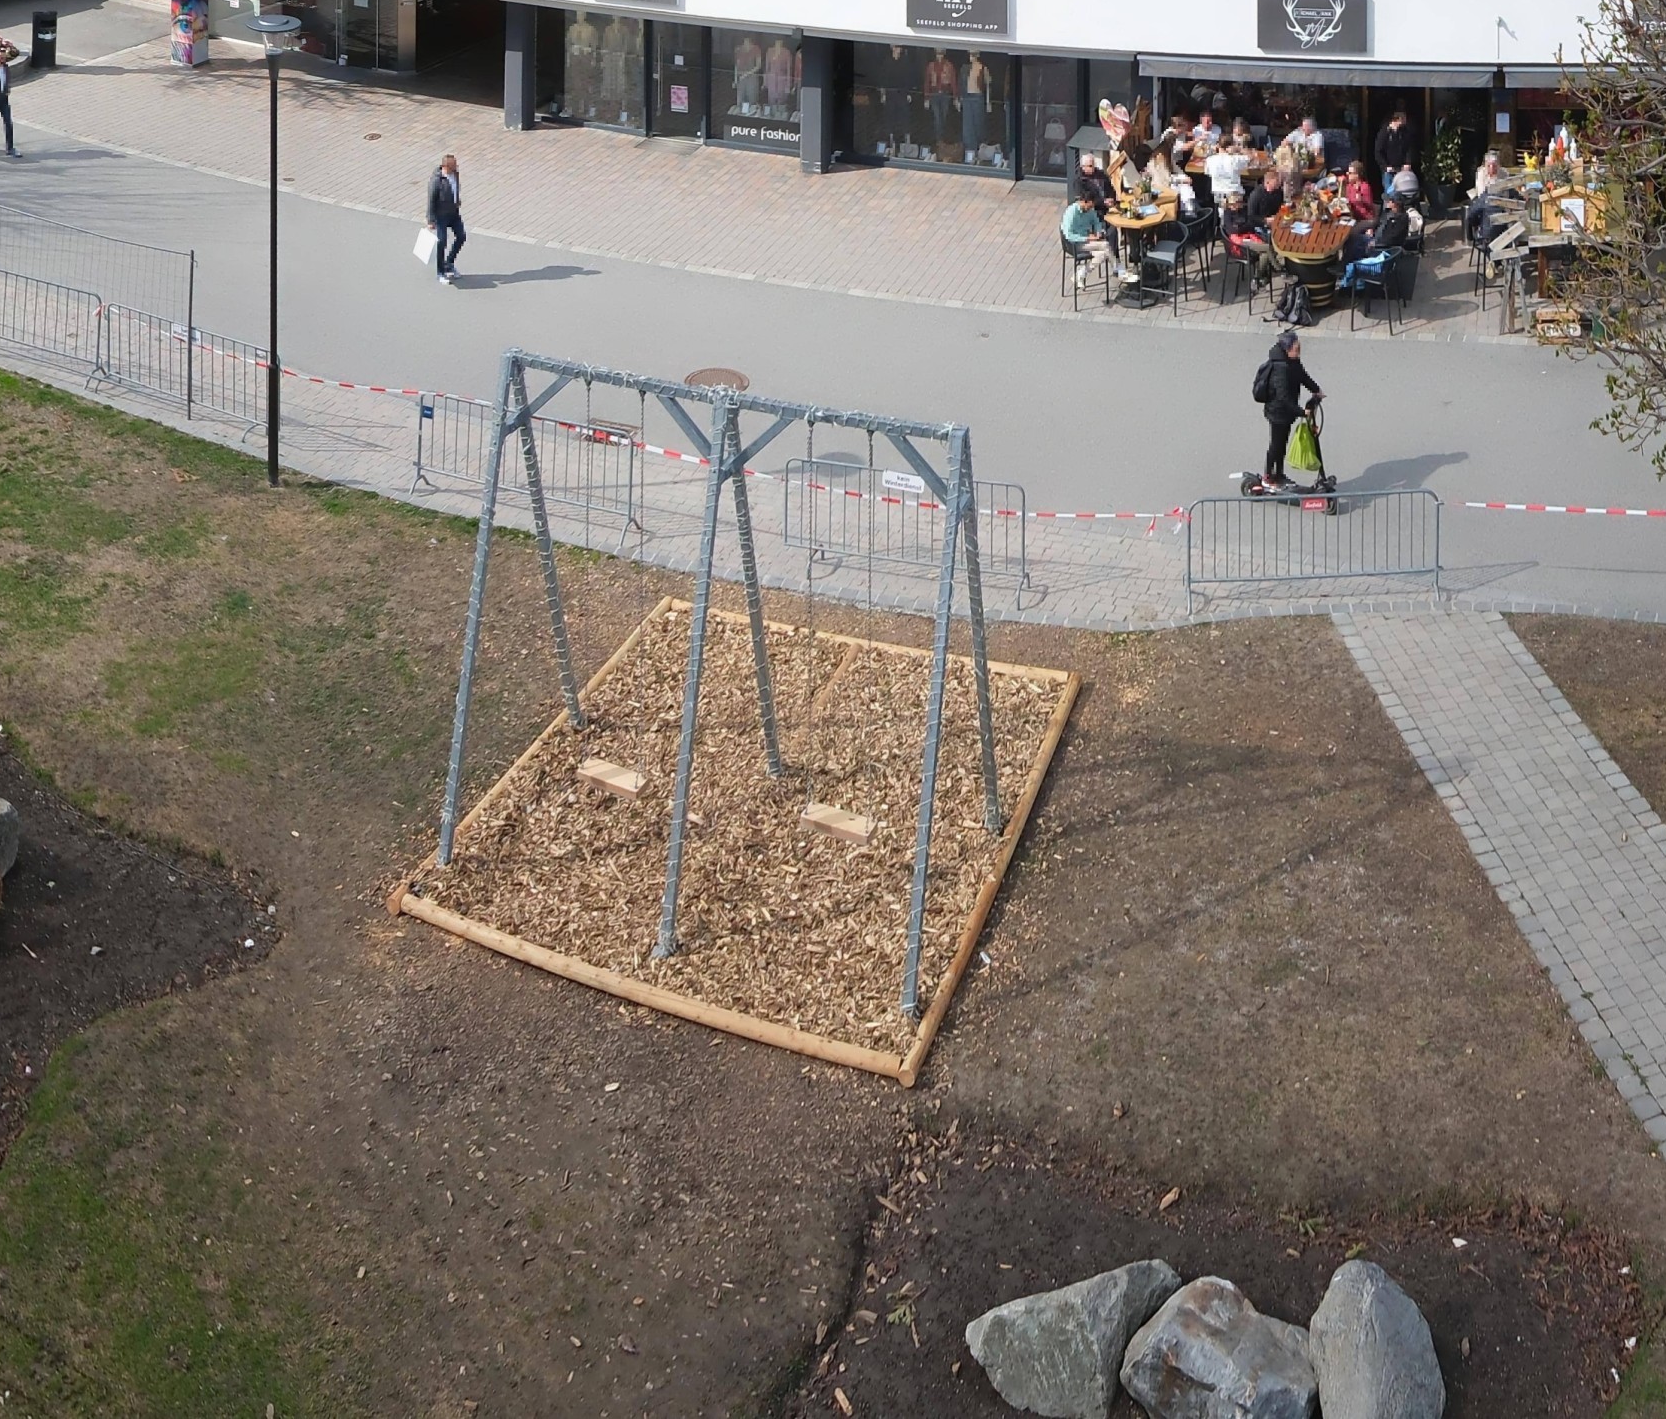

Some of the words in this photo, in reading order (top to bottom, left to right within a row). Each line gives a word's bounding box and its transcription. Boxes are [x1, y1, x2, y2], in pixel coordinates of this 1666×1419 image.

[916, 19, 945, 27] SEEFELD
[947, 21, 983, 29] SHOPPING
[731, 125, 757, 137] pure
